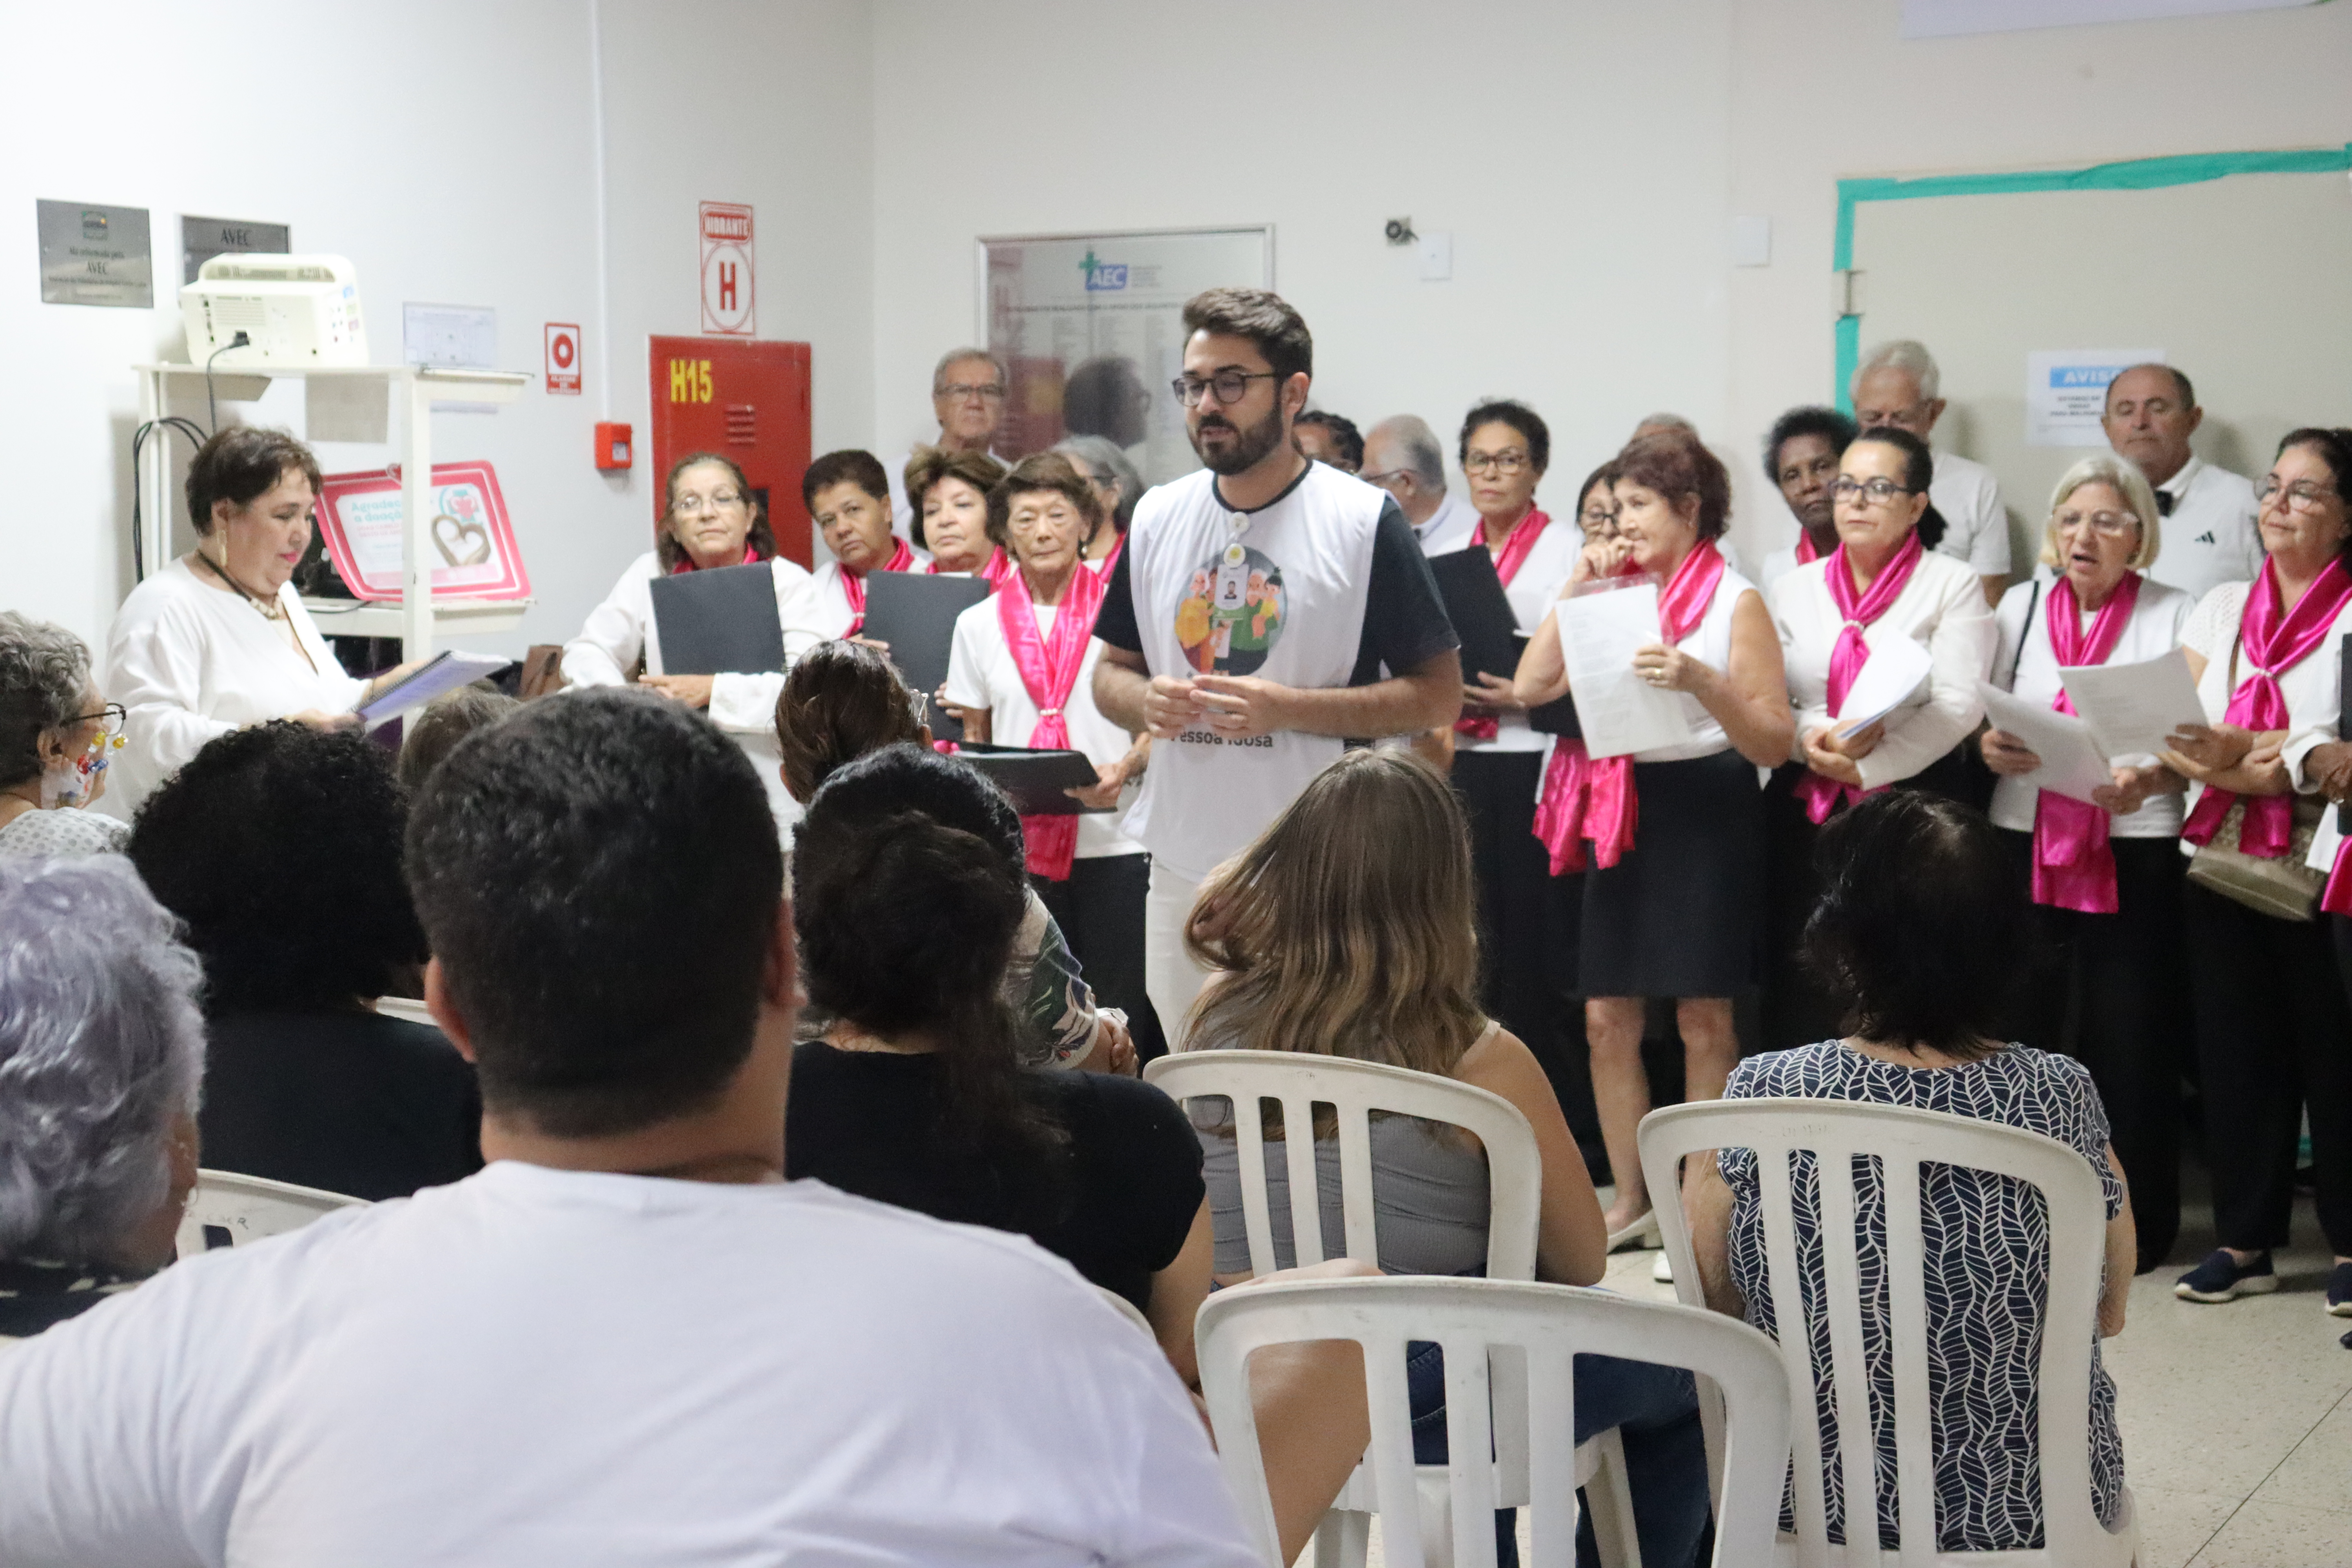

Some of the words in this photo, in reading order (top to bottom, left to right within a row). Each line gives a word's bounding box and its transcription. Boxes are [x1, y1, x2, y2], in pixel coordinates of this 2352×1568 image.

[705, 217, 750, 235] HIDRANTE
[220, 228, 252, 247] AVEC
[87, 261, 107, 275] AVEC
[1091, 268, 1124, 286] AEC
[719, 262, 736, 310] H
[670, 359, 713, 403] H15
[352, 500, 401, 512] Agradec
[364, 510, 402, 521] doaçã
[1171, 731, 1223, 744] essoa
